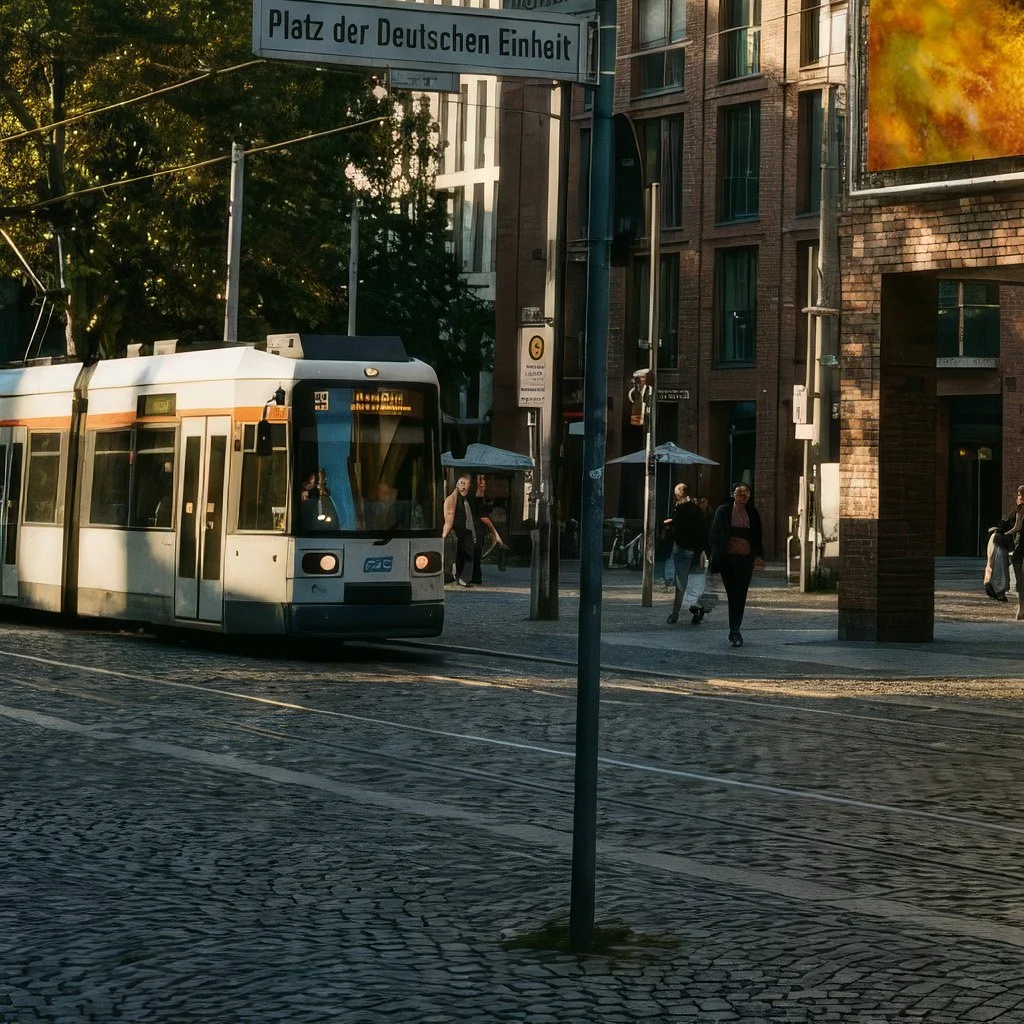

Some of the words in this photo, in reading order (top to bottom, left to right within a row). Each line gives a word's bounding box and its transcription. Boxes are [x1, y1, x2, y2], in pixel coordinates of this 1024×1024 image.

[269, 9, 324, 41] Platz
[333, 15, 370, 45] der
[377, 18, 490, 55] Deutschen
[499, 28, 572, 61] Einheit
